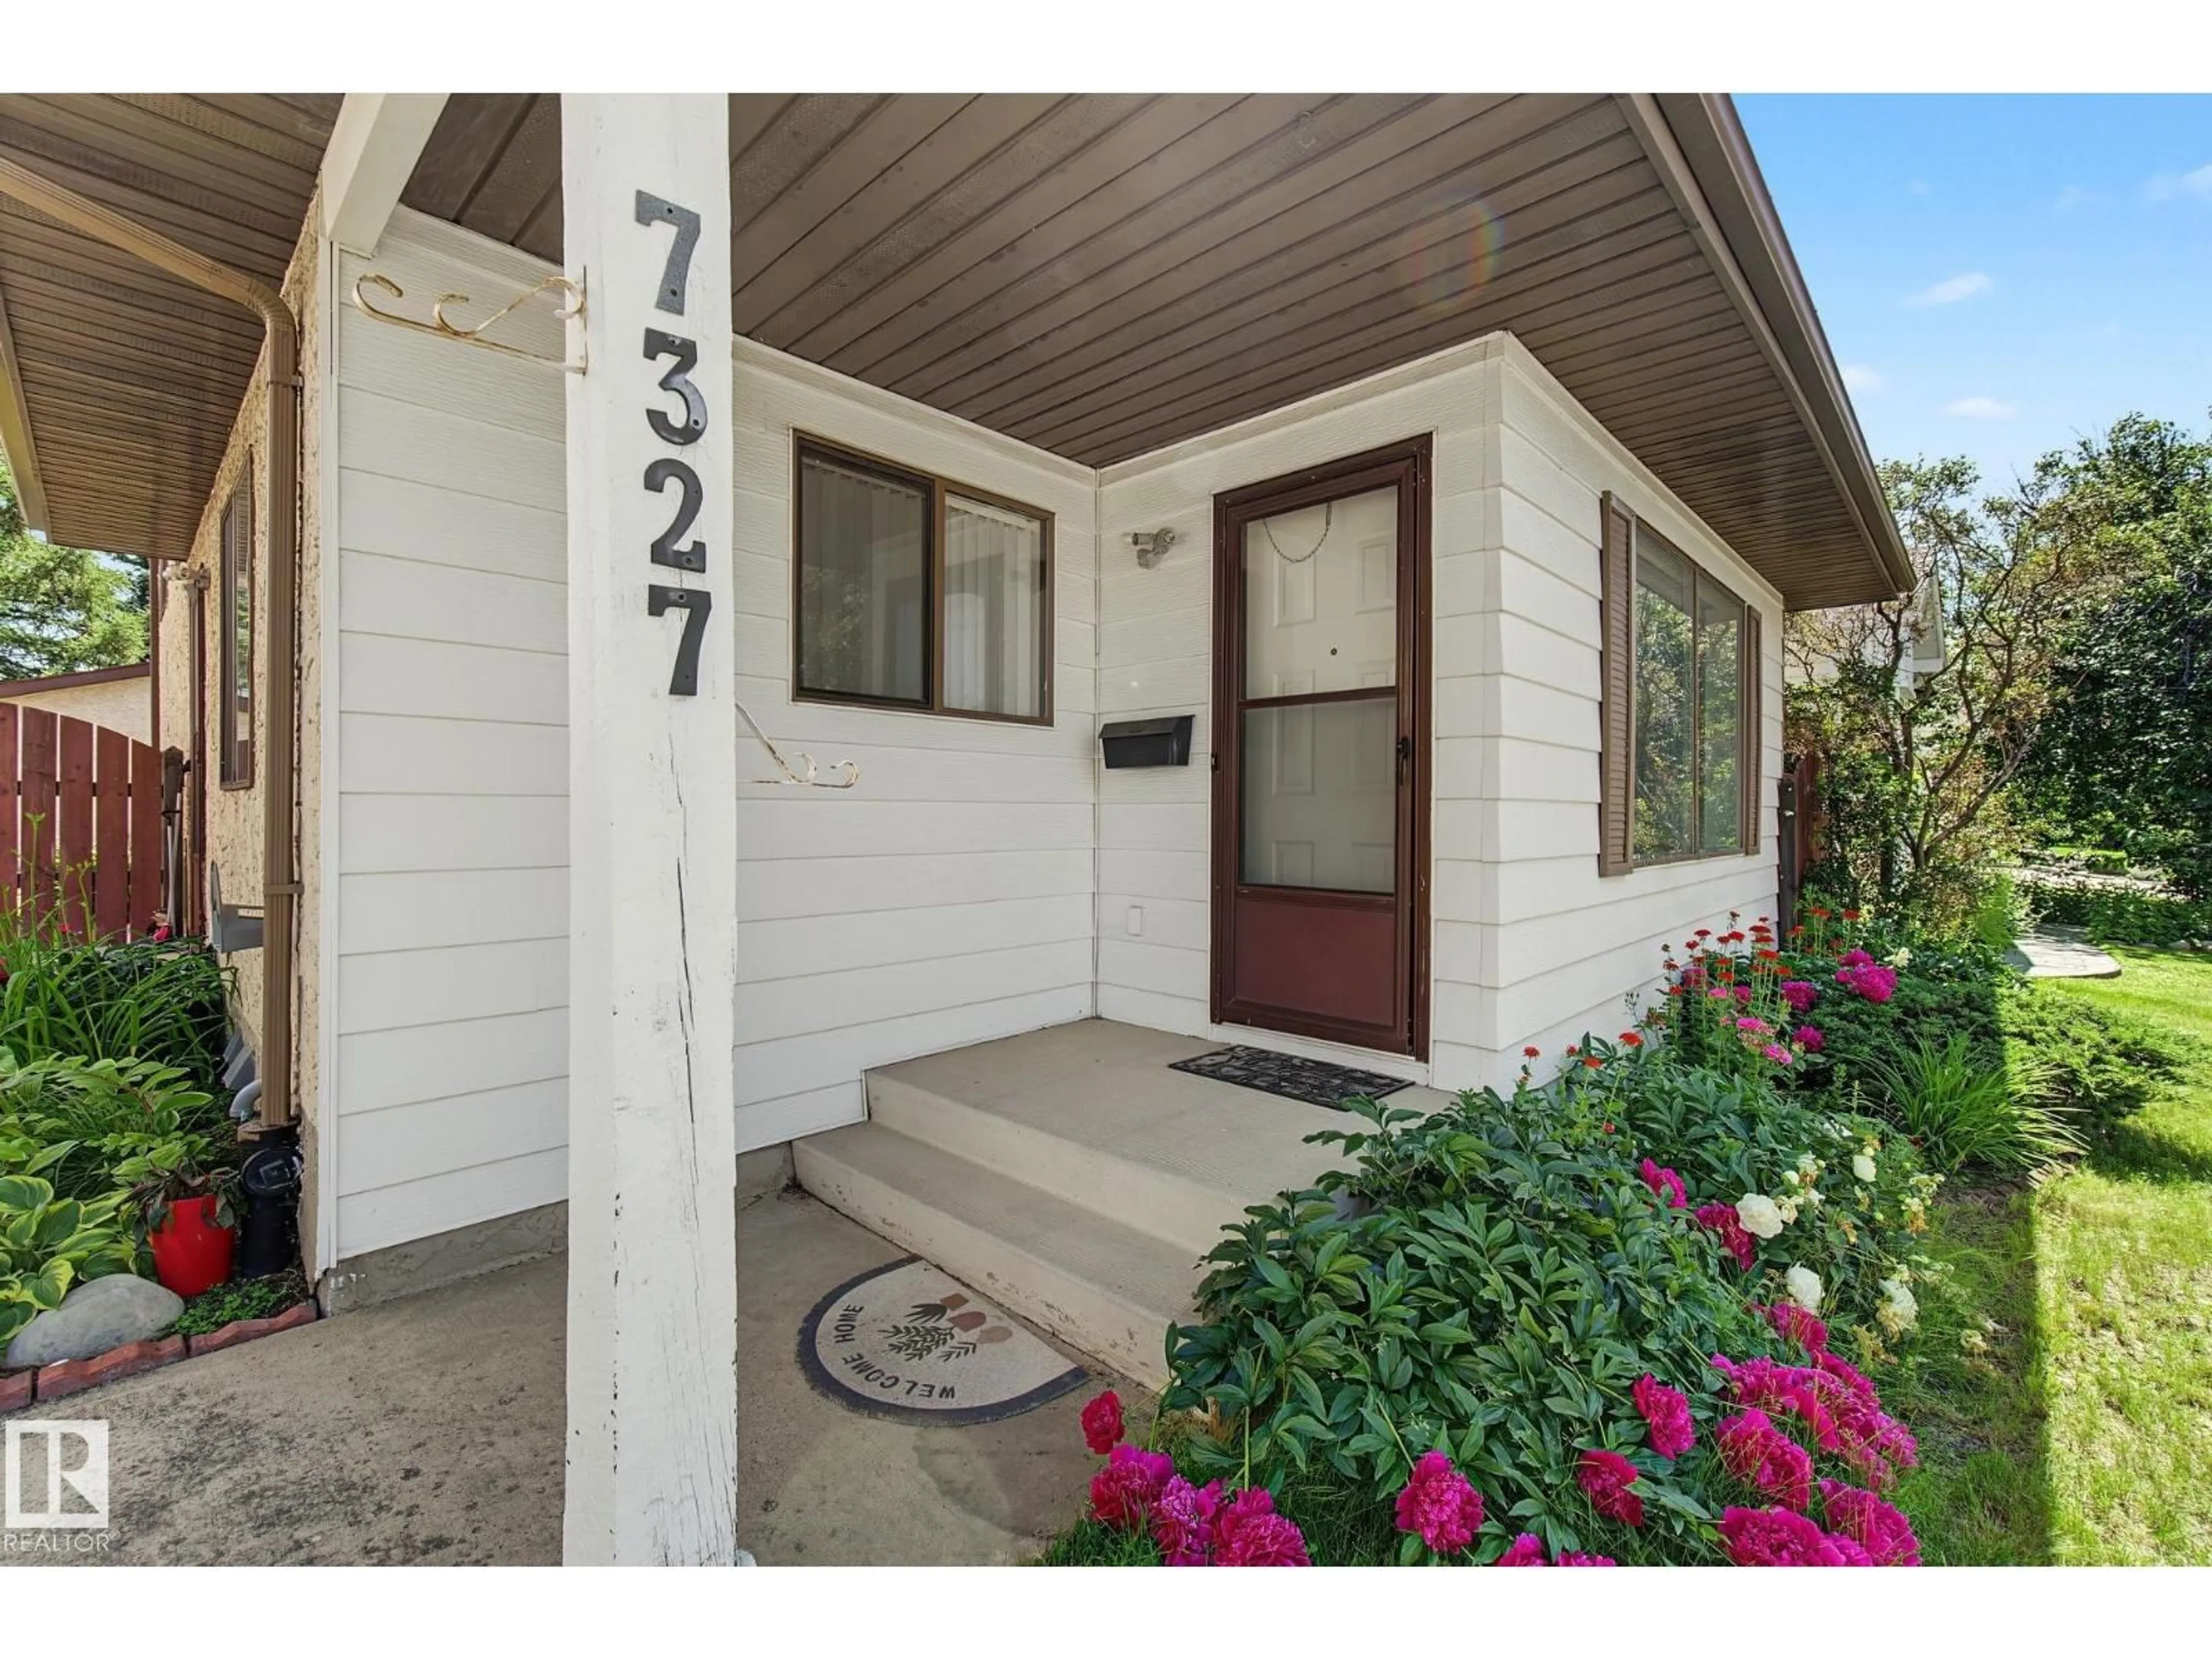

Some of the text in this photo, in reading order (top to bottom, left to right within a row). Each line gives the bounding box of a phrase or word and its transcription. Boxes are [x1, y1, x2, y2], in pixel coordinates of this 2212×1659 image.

[635, 189, 711, 696] 7327
[834, 1304, 955, 1399] WELCOME HOME
